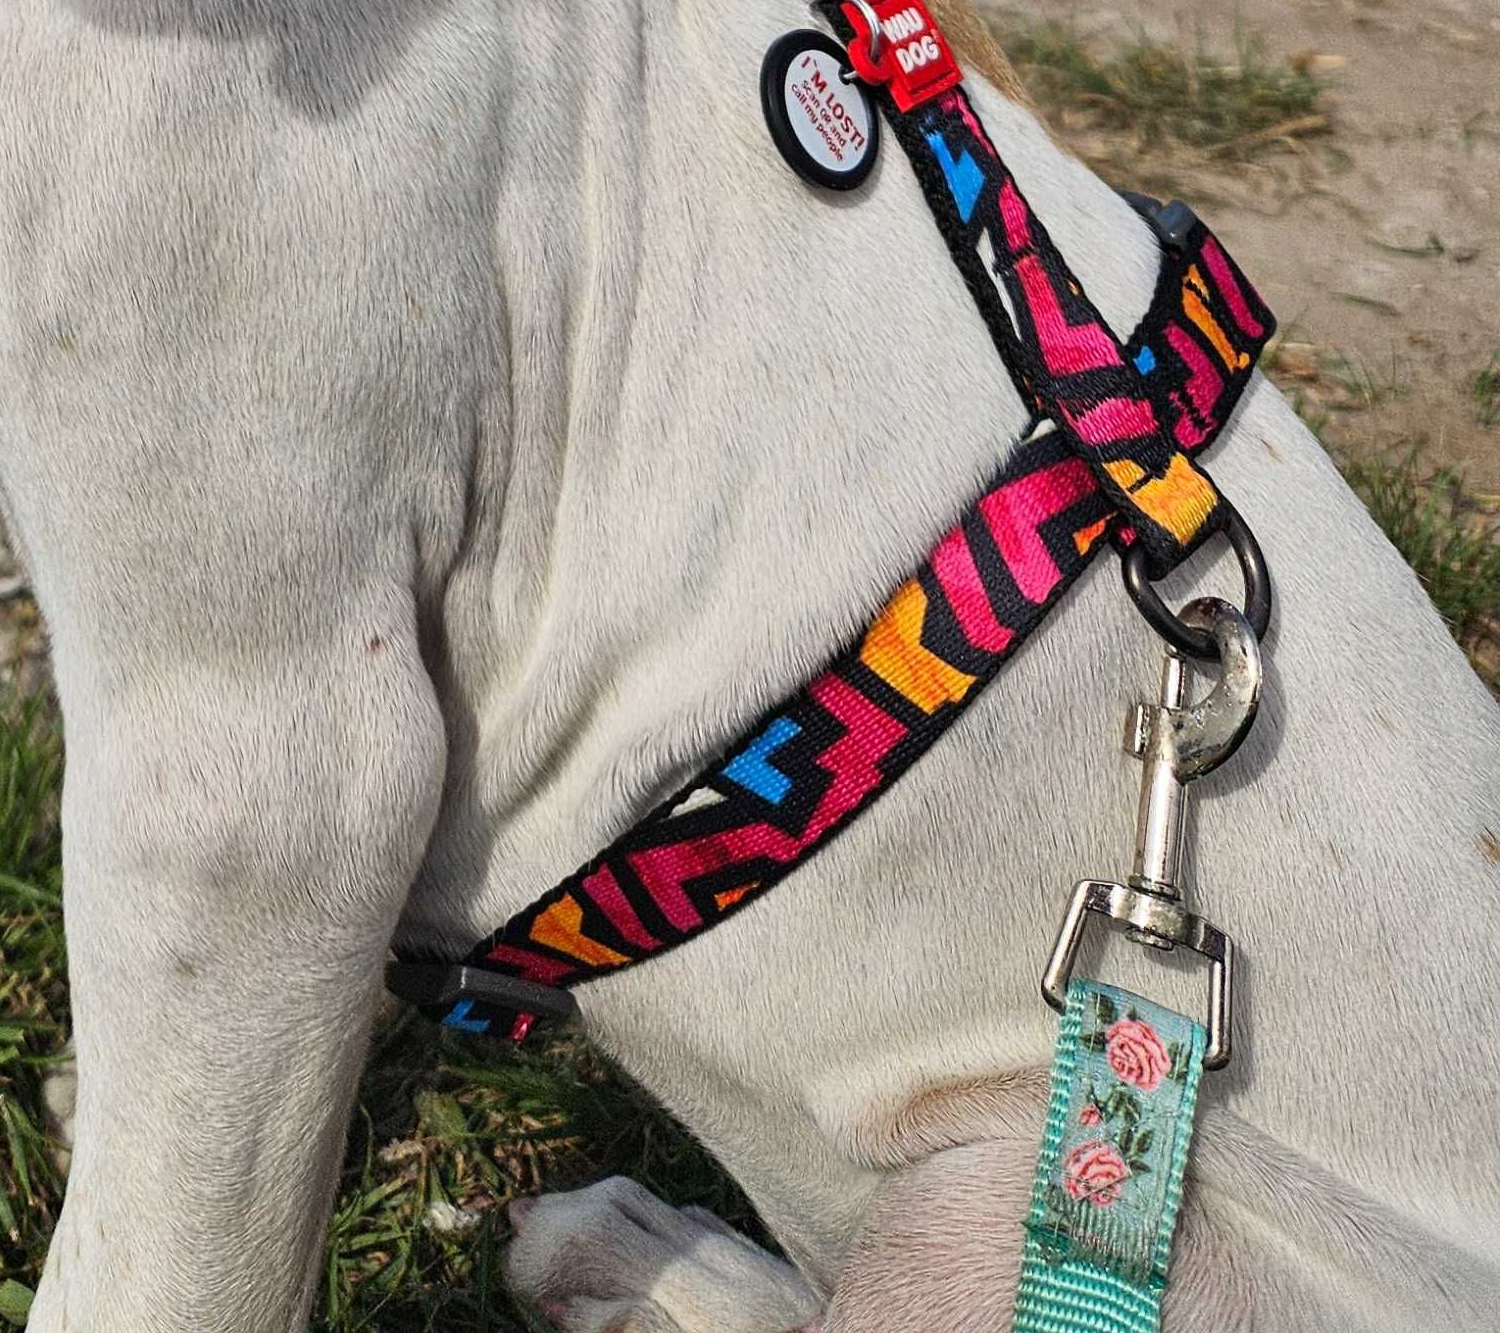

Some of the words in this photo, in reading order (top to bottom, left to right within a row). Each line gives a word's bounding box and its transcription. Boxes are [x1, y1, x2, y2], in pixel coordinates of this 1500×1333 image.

[879, 7, 924, 44] WAU
[895, 35, 939, 75] DOG
[791, 83, 807, 109] call
[804, 105, 819, 124] my
[816, 123, 843, 162] people
[801, 80, 821, 108] scan
[830, 125, 847, 147] and
[825, 92, 865, 151] LOST!
